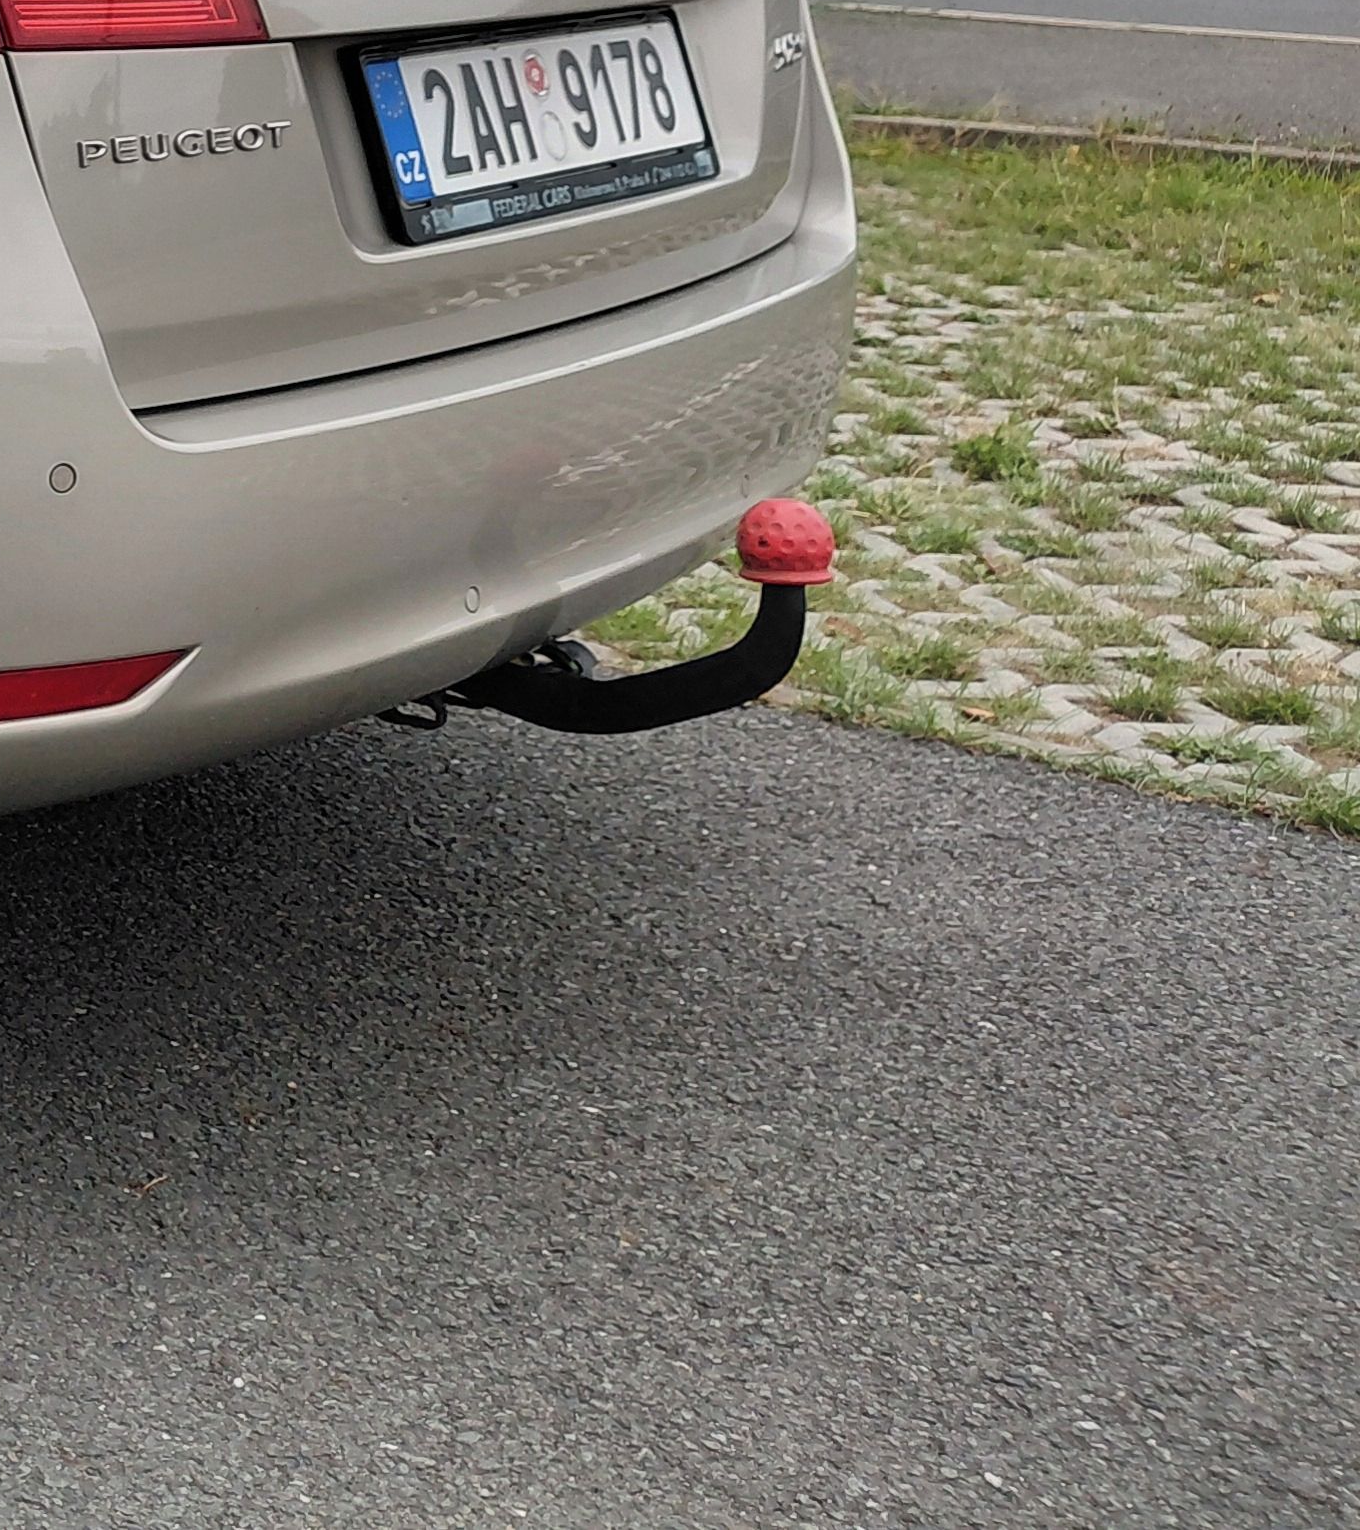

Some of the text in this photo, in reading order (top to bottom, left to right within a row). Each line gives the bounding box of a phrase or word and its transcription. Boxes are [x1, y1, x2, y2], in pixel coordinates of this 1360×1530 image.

[423, 37, 677, 177] 2AH 9178
[76, 120, 292, 169] PEUGEOT
[394, 149, 427, 185] CZ
[492, 184, 571, 219] FEDERAL CARS
